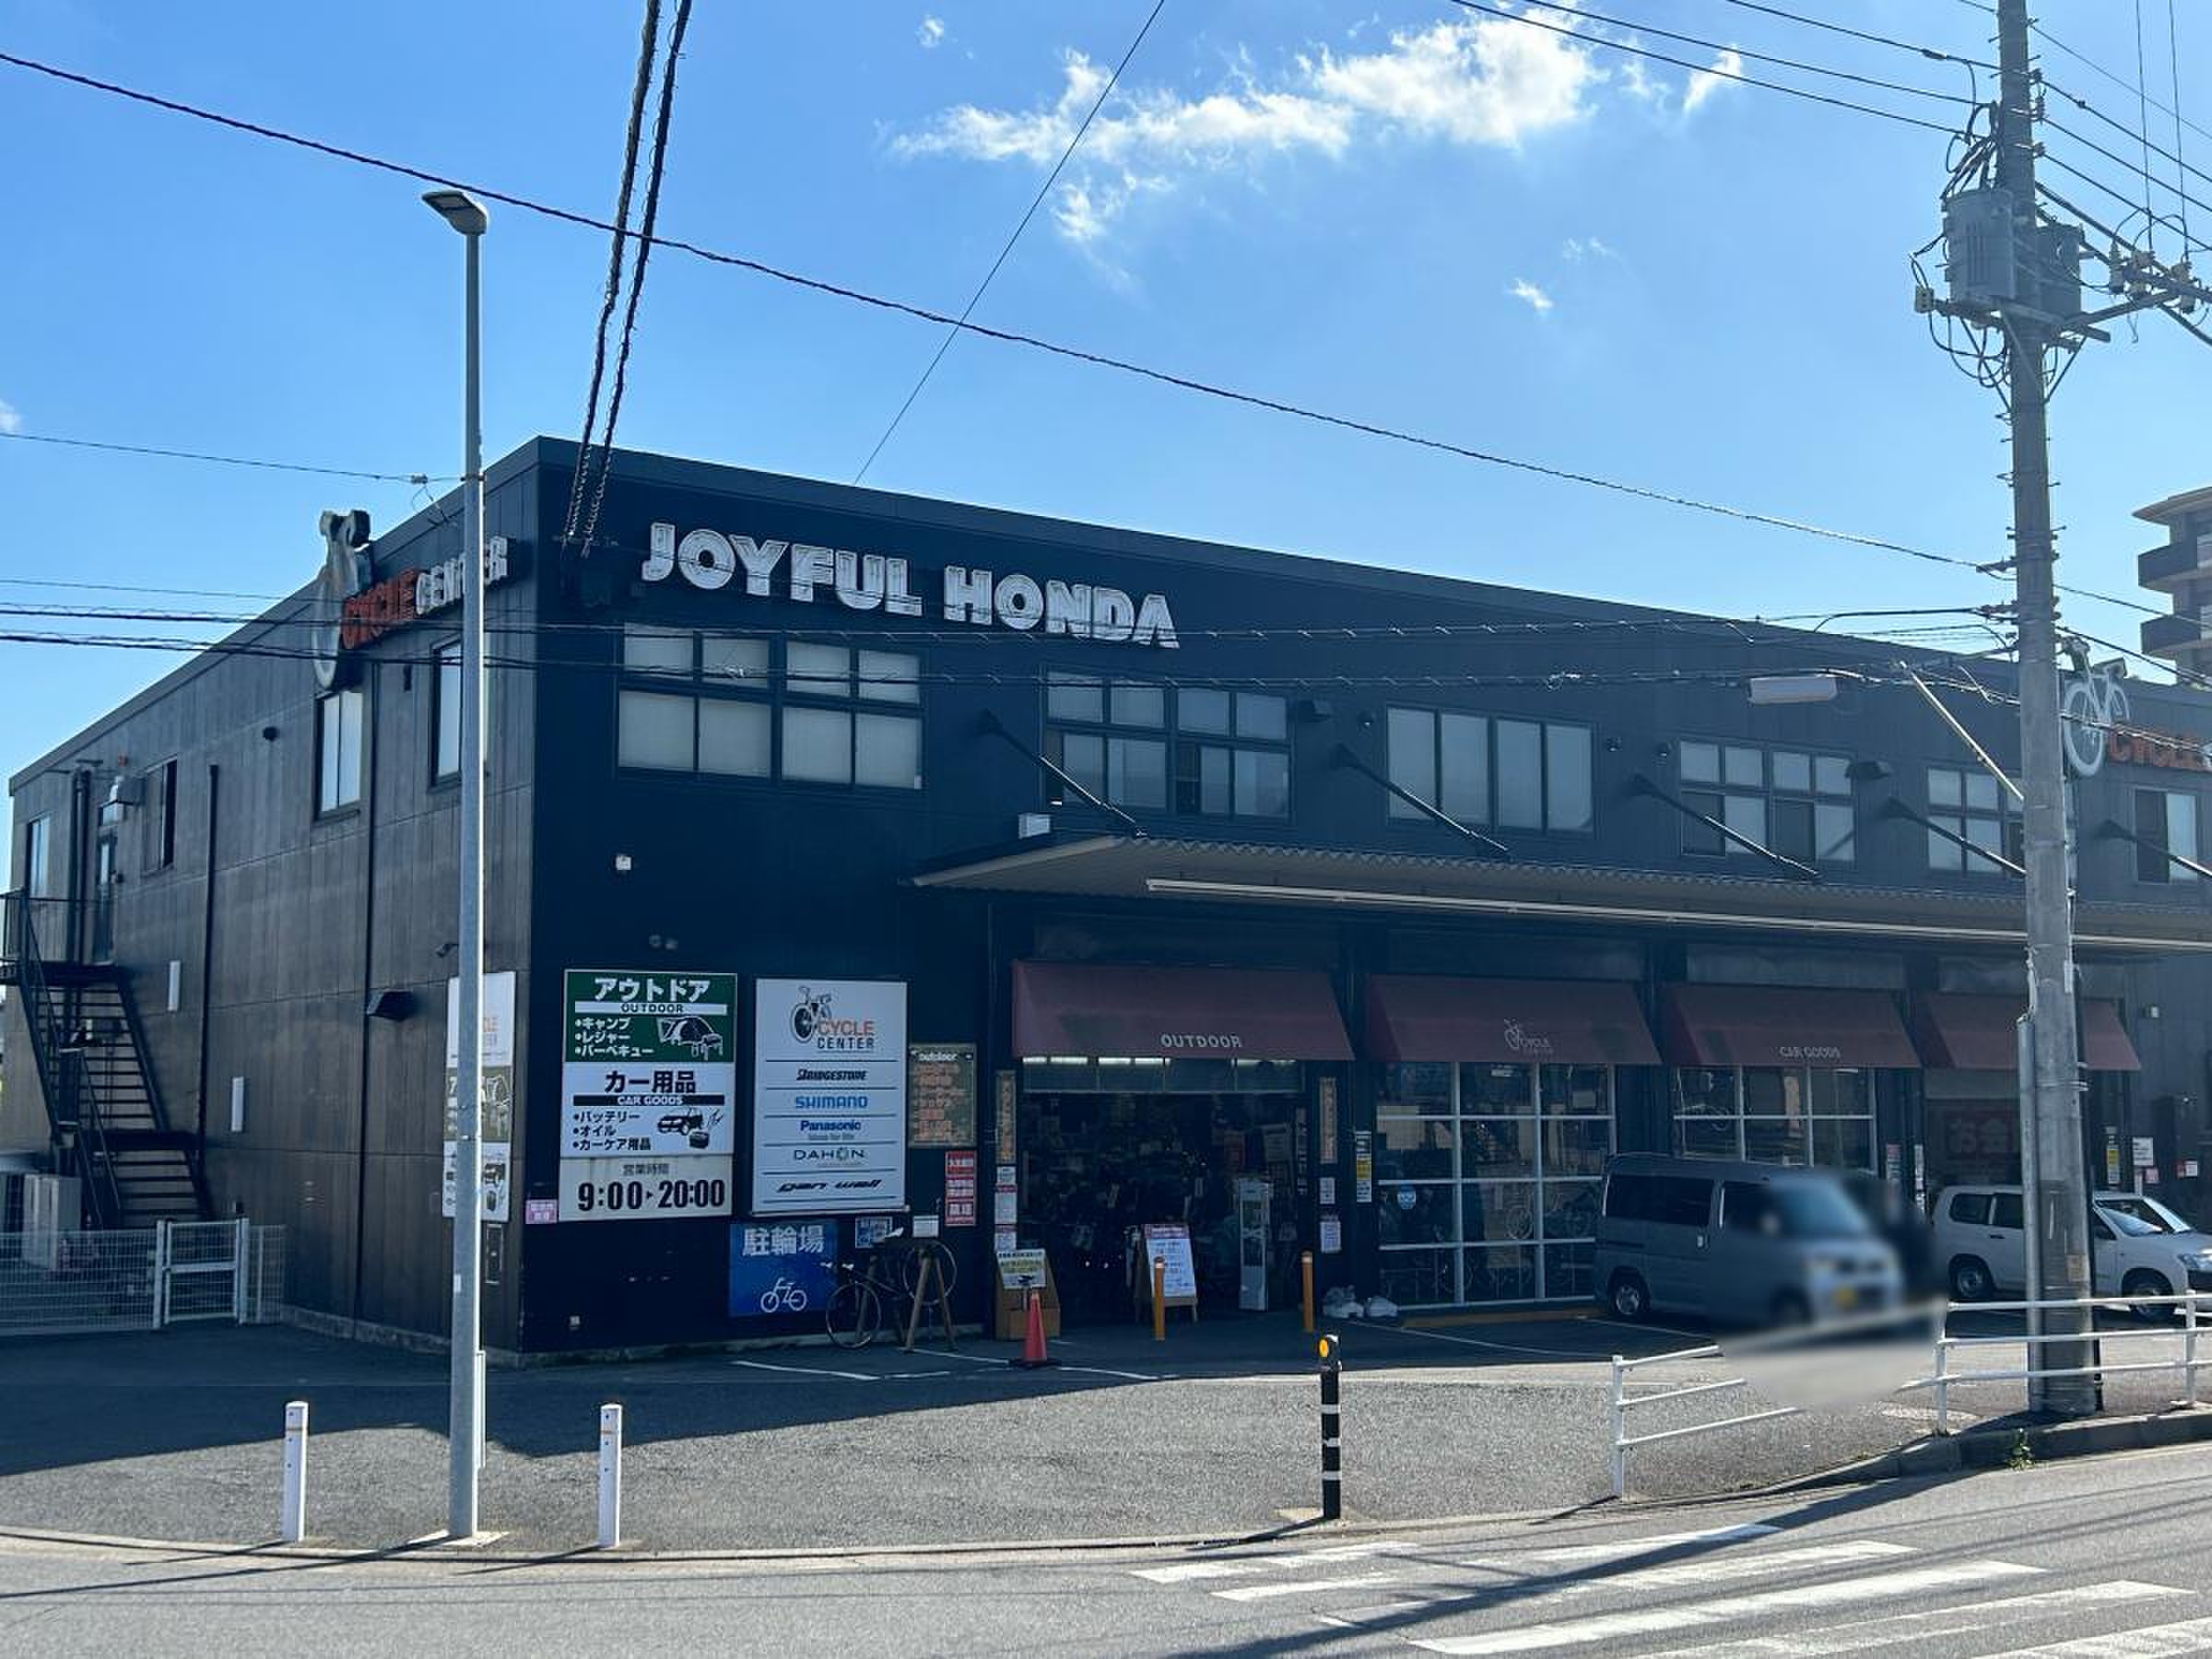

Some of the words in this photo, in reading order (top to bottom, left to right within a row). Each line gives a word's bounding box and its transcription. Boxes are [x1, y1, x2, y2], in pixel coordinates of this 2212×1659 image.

[642, 523, 923, 617] JOYFUL
[944, 564, 1181, 649] HONDA
[594, 978, 711, 1002] アウトドア
[620, 1004, 684, 1014] OUTDOOR
[818, 1019, 876, 1036] CYCLE
[817, 1037, 876, 1050] CENTER
[1160, 1033, 1242, 1048] OUTDOOR
[605, 1070, 697, 1094] カー用品
[795, 1096, 868, 1109] SHIMANO
[580, 1125, 617, 1137] オイル
[794, 1147, 865, 1161] DAHON
[577, 1182, 642, 1212] 9:00
[658, 1179, 725, 1209] 20:00
[742, 1225, 825, 1256] 駐輪場
